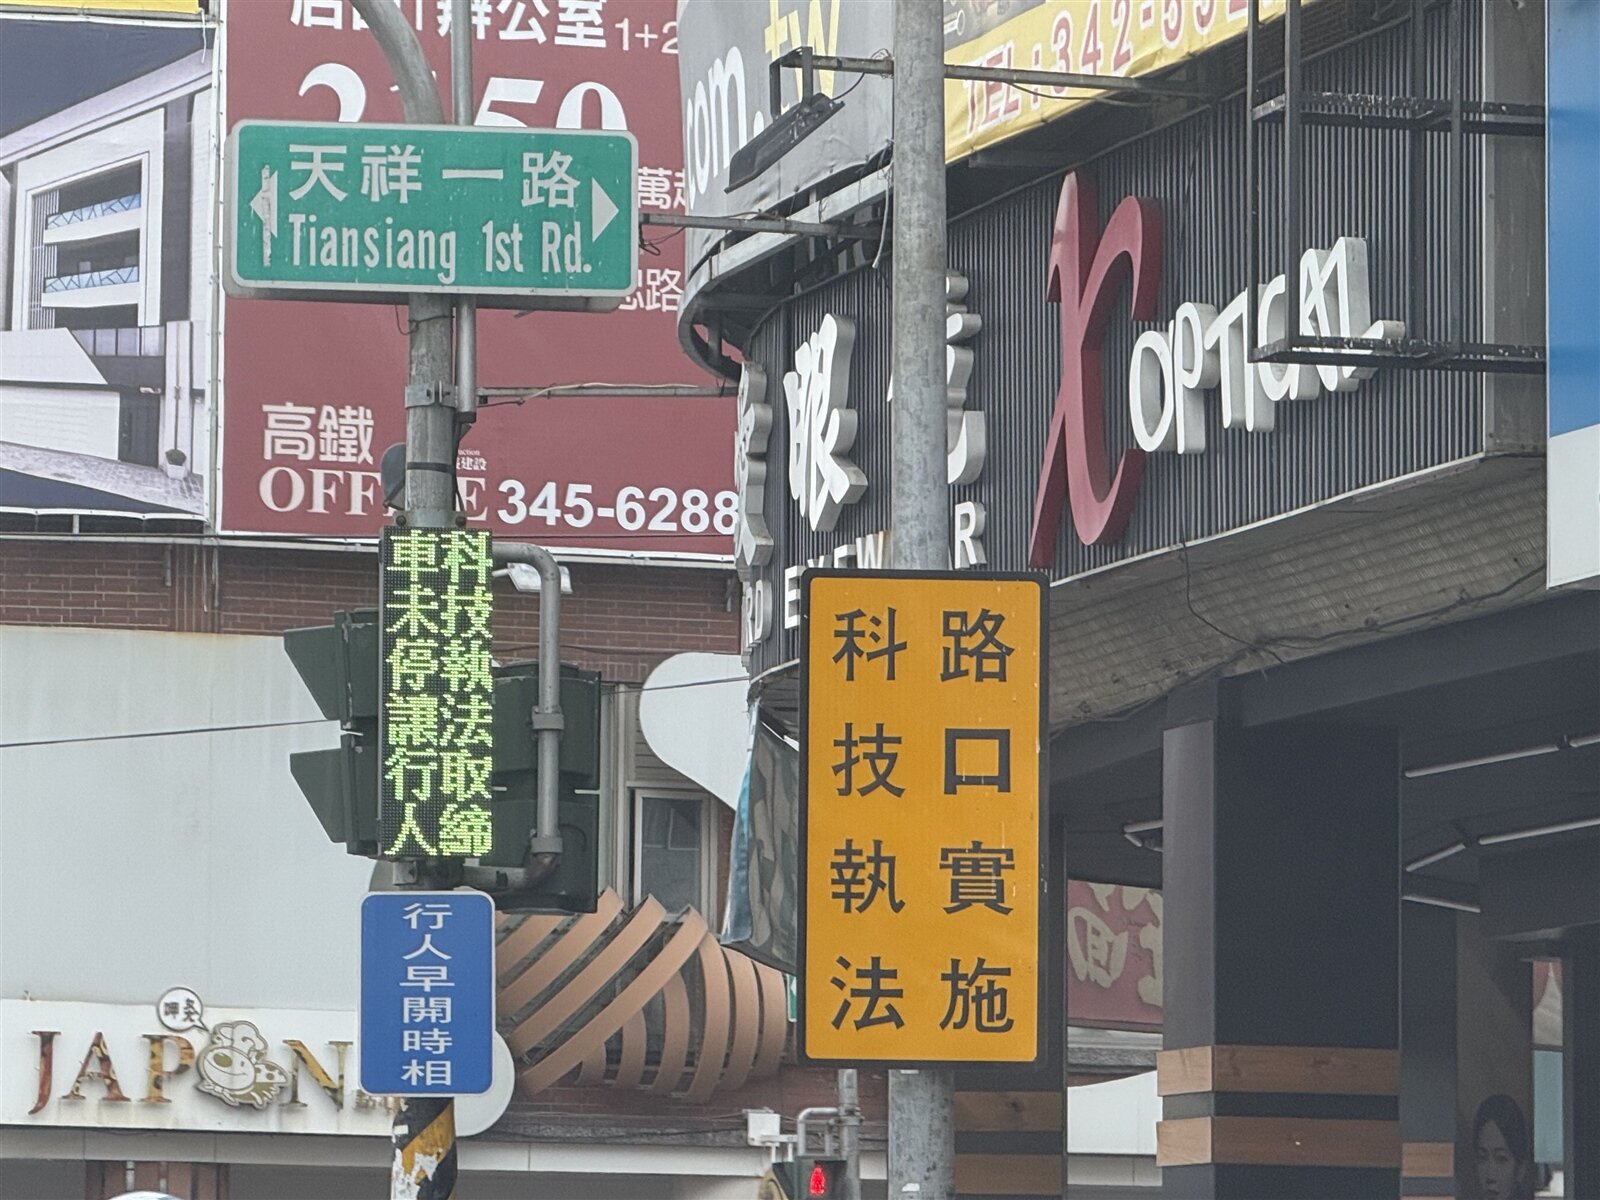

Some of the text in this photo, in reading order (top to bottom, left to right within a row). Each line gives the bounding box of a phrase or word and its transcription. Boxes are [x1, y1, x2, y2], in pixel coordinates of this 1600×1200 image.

[288, 143, 581, 209] 天祥一路
[289, 213, 593, 285] Tiansiang 1st Rd.
[258, 466, 739, 535] OFFE 345-6288
[261, 401, 375, 464] 高鐵
[384, 529, 440, 857] 車未停讓行人
[439, 530, 494, 858] 科技執法取締
[830, 607, 908, 1033] 科技執法
[939, 608, 1016, 1034] 路口實施
[399, 902, 455, 1087] 行人早開時相
